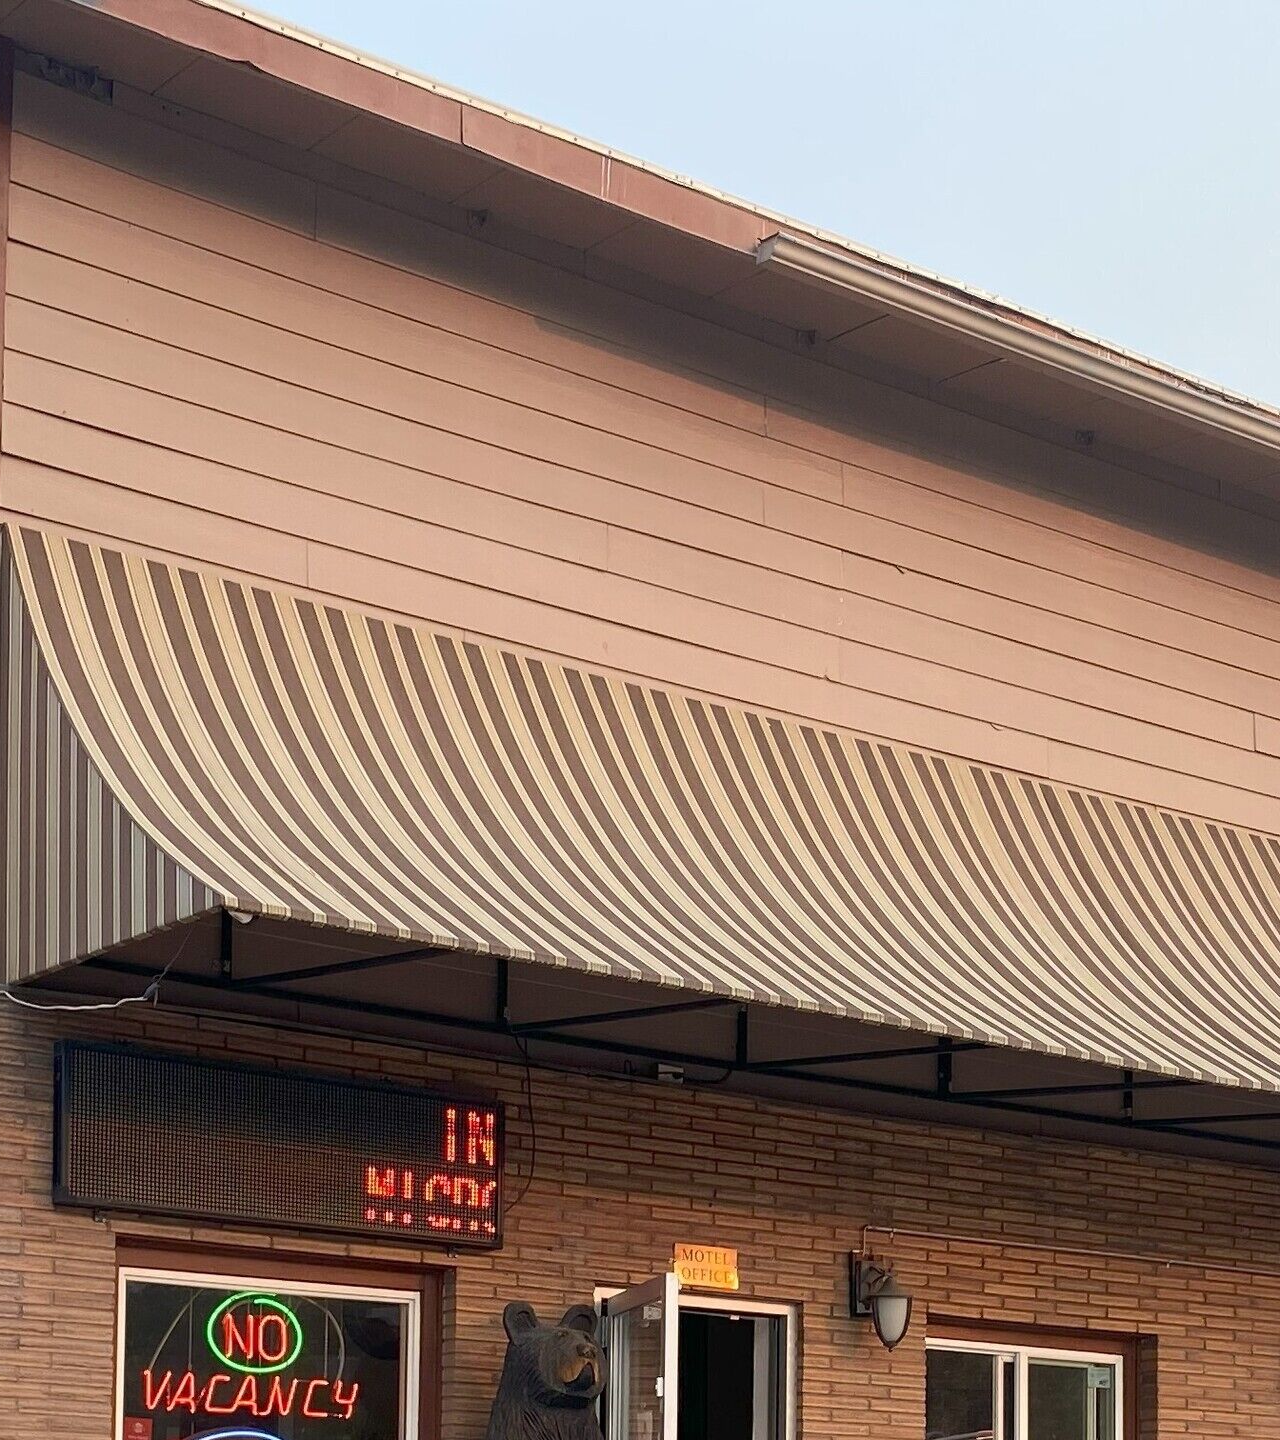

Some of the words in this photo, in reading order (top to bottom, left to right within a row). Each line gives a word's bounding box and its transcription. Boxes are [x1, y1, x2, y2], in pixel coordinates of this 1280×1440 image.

[446, 1108, 495, 1167] IN
[681, 1266, 733, 1284] OFFICE
[682, 1247, 731, 1266] MOTEL
[223, 1312, 288, 1361] NO
[143, 1369, 359, 1419] VACANCY
